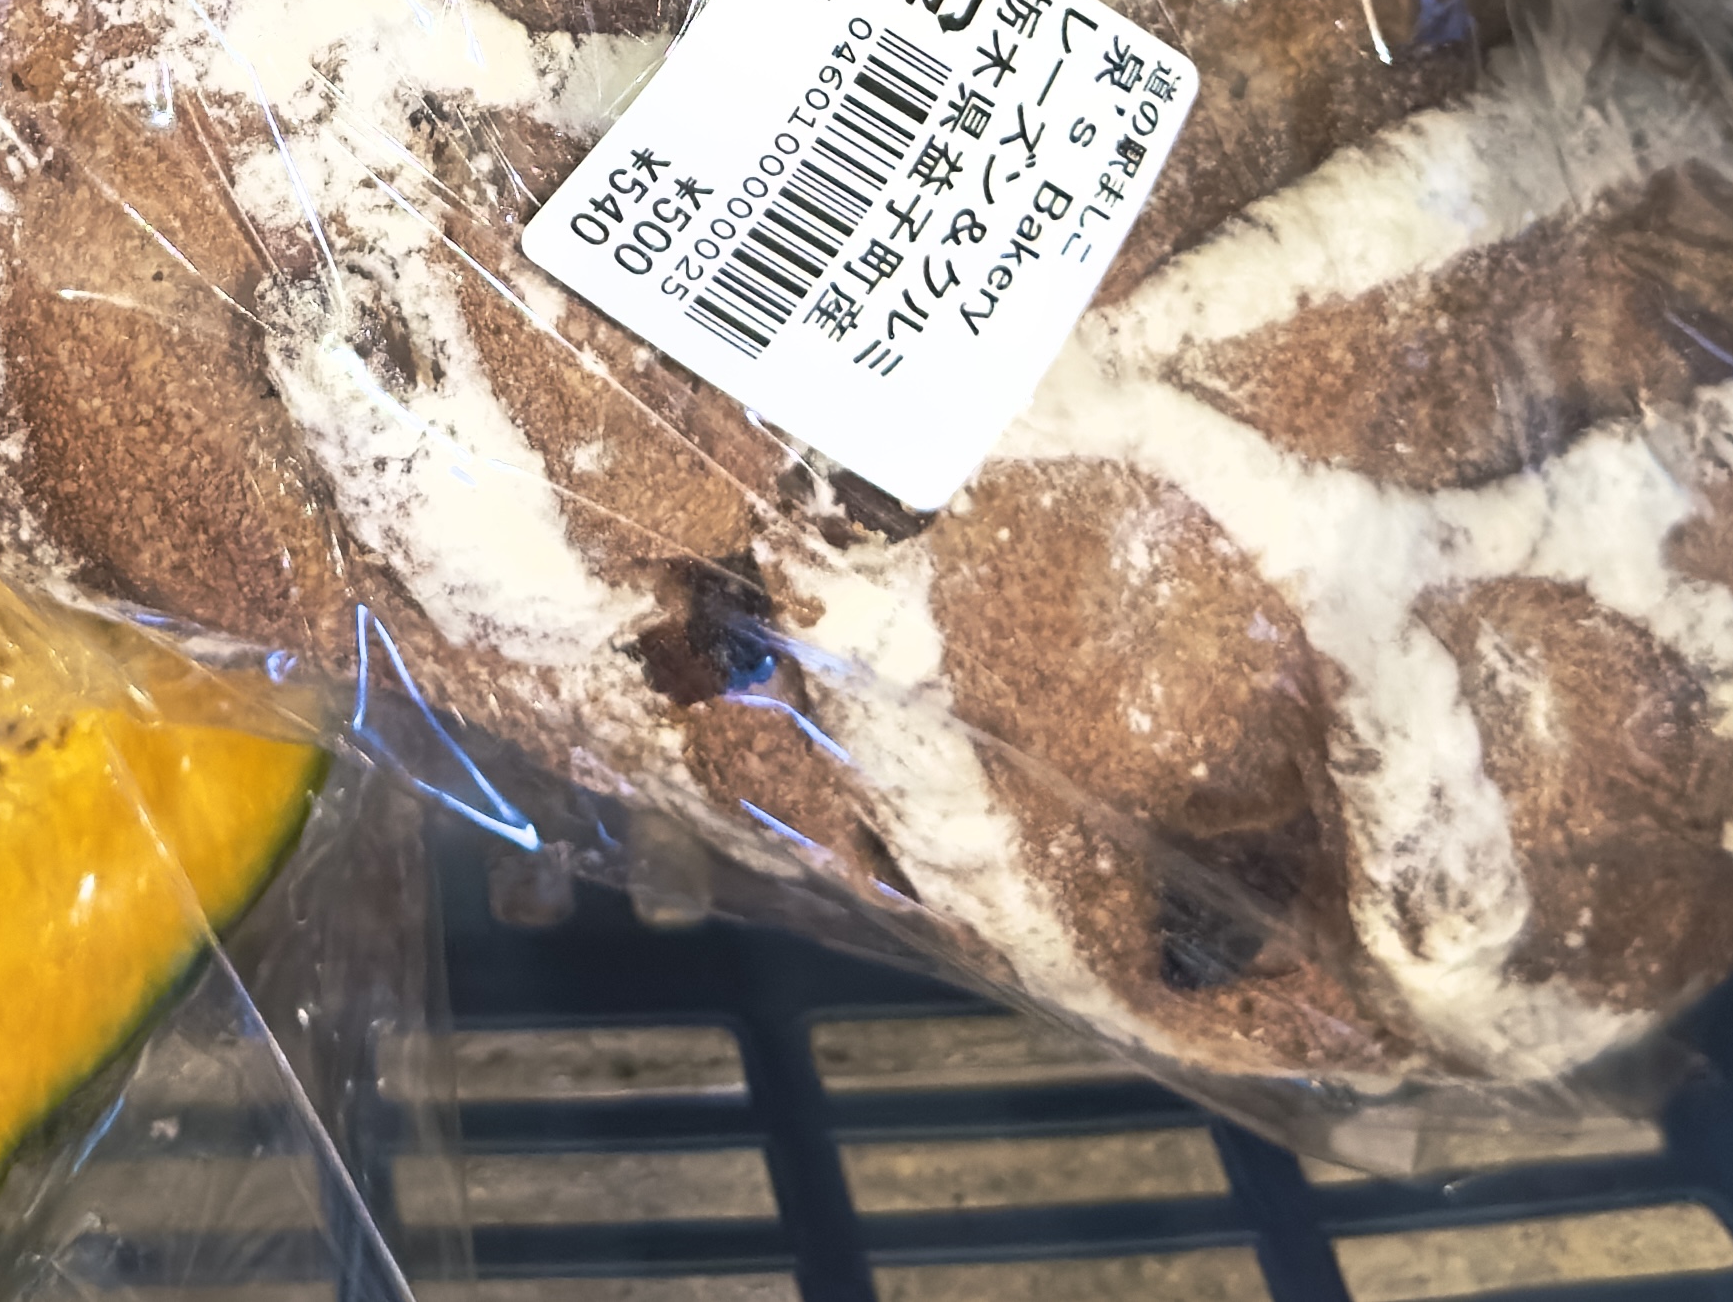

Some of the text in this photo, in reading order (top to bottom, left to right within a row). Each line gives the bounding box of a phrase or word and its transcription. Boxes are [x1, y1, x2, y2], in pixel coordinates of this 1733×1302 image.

[572, 146, 671, 247] ¥540
[615, 175, 712, 276] ¥500
[659, 16, 874, 302] 0460100000025
[1060, 60, 1183, 264] 道の駅ましこ
[962, 179, 1072, 337] Bakery
